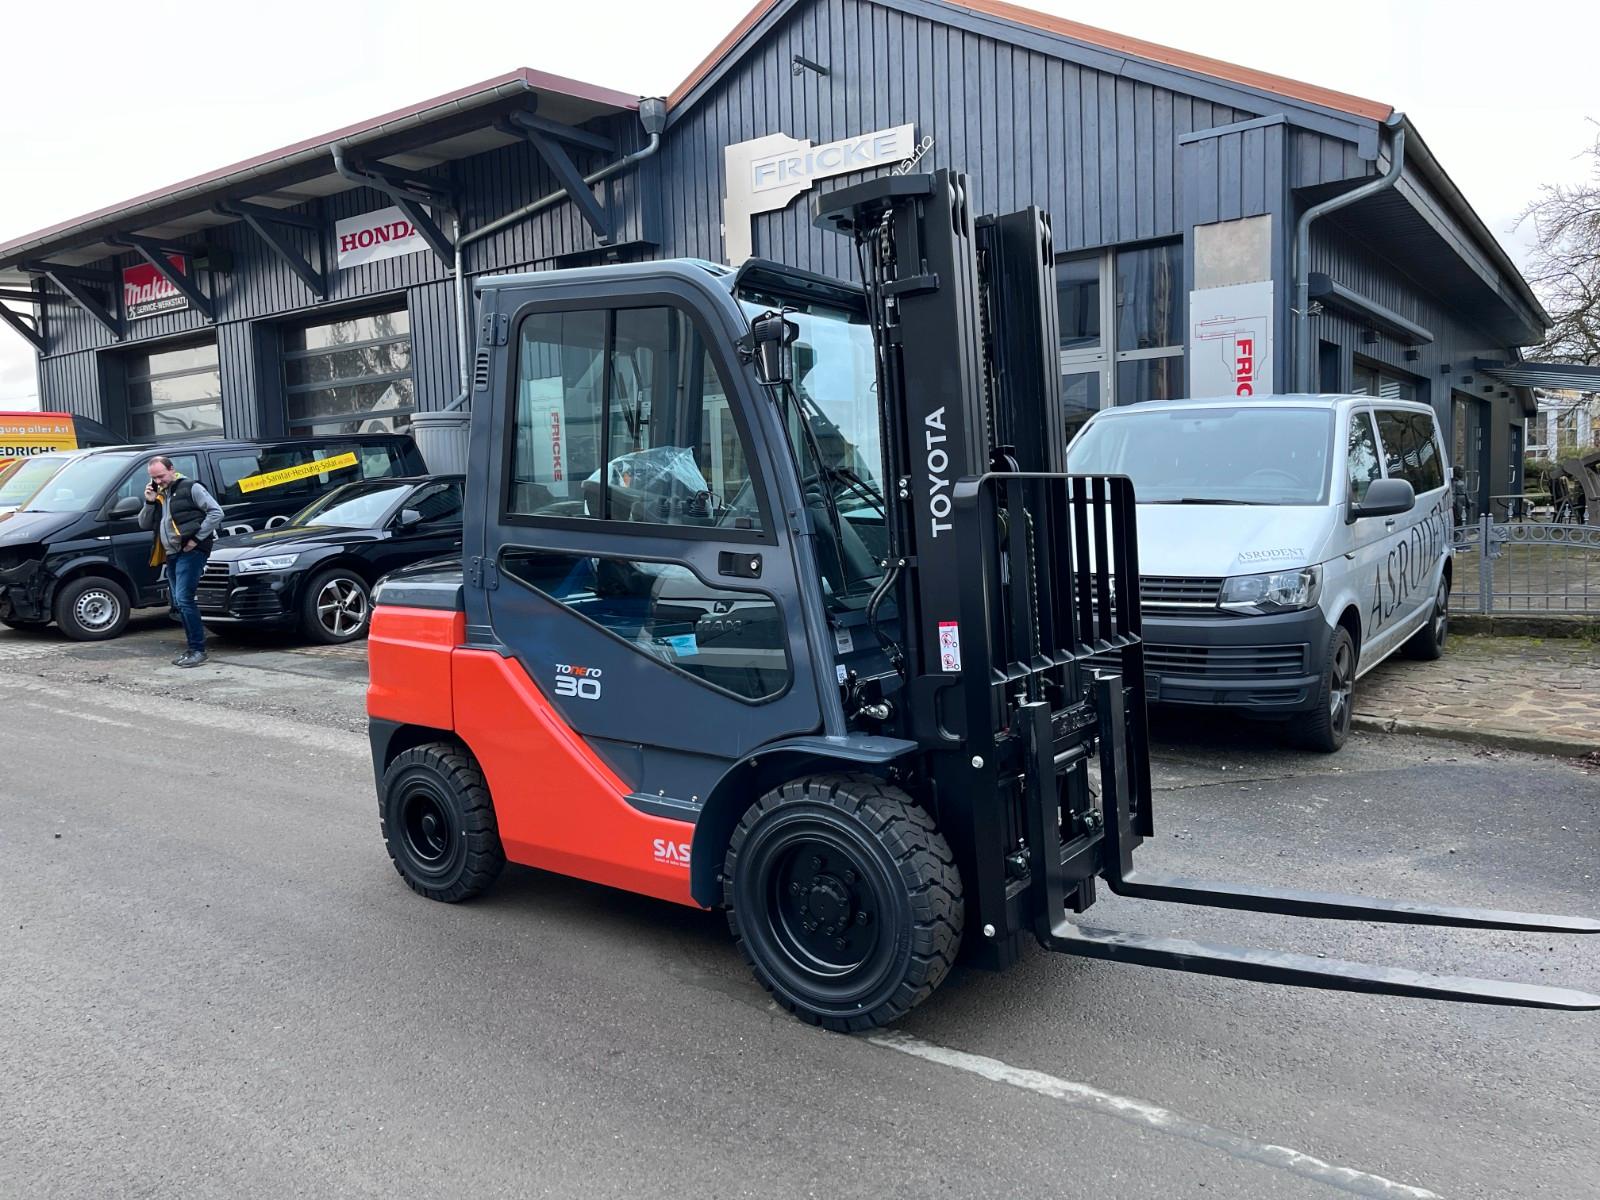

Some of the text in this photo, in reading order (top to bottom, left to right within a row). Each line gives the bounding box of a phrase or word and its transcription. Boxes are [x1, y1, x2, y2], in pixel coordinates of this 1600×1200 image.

[755, 133, 897, 187] FRICKE
[886, 135, 934, 176] istro
[1236, 339, 1253, 396] FRIC
[551, 412, 562, 482] FRICKE
[925, 406, 953, 538] TOYOTA
[1238, 548, 1304, 561] ASRODENT
[554, 675, 601, 700] 30
[653, 838, 691, 862] SAS
